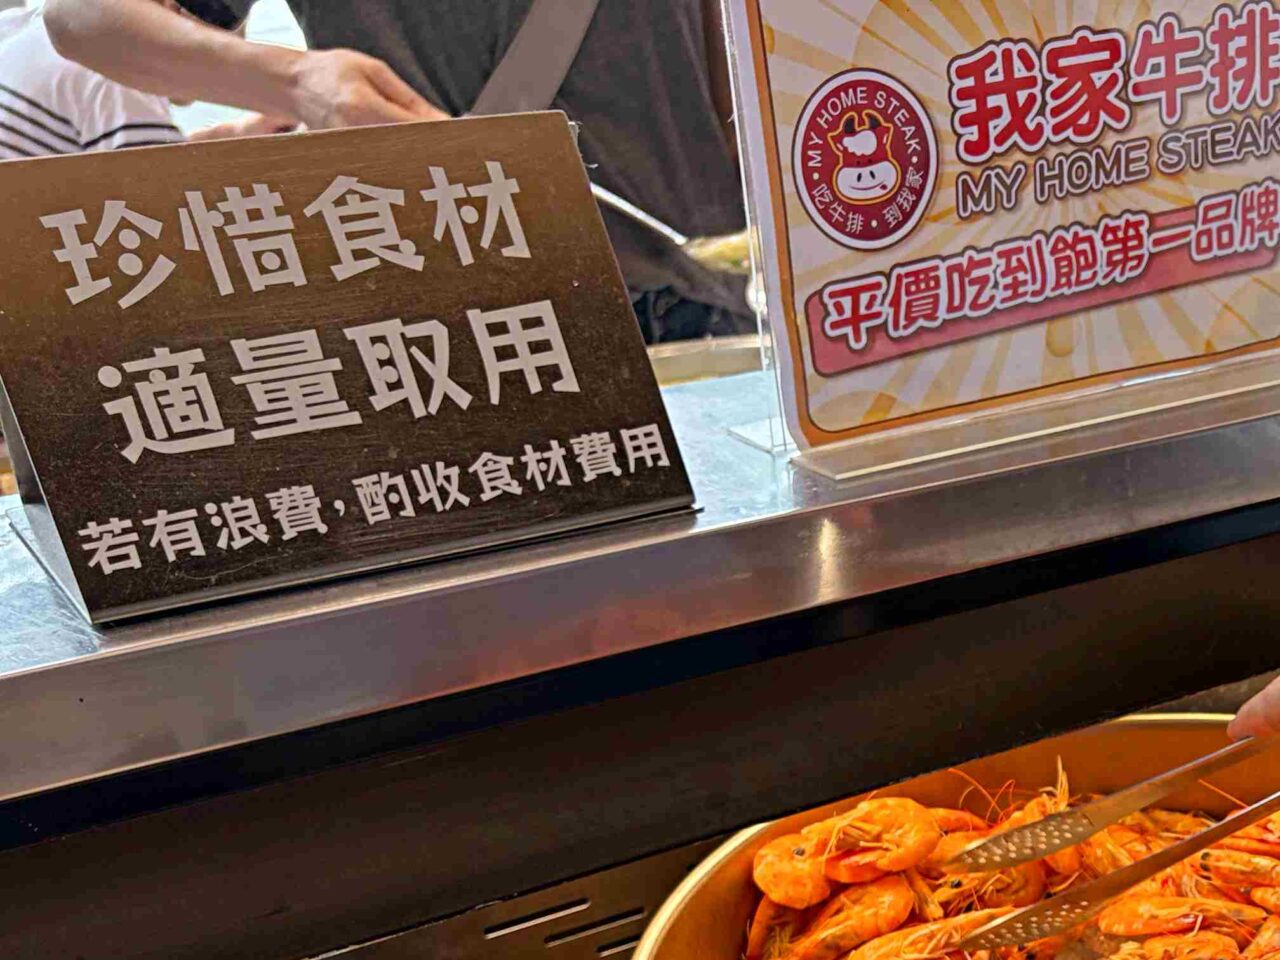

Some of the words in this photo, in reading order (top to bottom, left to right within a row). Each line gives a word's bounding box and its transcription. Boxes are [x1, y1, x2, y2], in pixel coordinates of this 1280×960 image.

[815, 86, 868, 129] HOME
[873, 90, 922, 155] STEAK
[807, 131, 824, 168] MY
[956, 163, 1026, 219] MY
[1036, 135, 1150, 202] HOME
[39, 160, 533, 310] 珍惜食材
[812, 183, 865, 235] 吃牛排
[881, 166, 924, 229] 到我家
[96, 299, 582, 465] 適量取用
